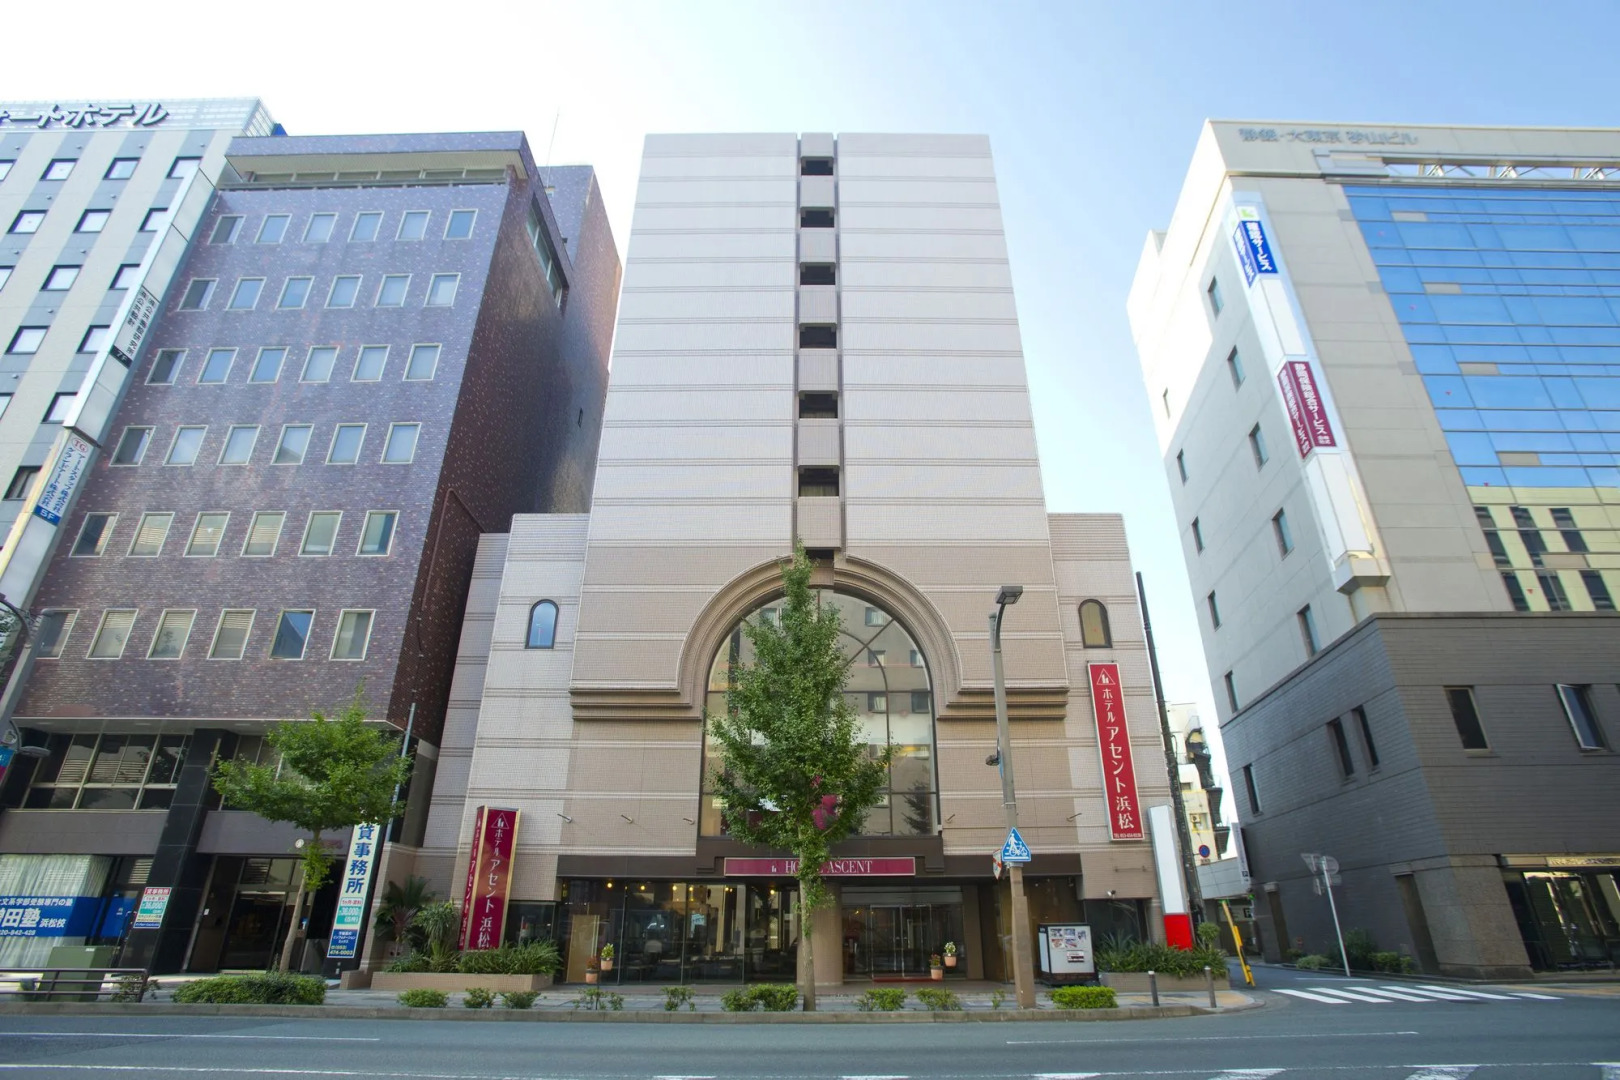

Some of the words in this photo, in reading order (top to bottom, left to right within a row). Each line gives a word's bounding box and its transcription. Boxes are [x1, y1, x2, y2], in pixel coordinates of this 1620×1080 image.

[0, 103, 168, 128] ートホテル
[116, 351, 128, 361] 7F
[75, 439, 87, 451] TG
[40, 510, 55, 520] 5F
[345, 824, 375, 894] 貸事務所
[828, 860, 872, 873] ASCENT
